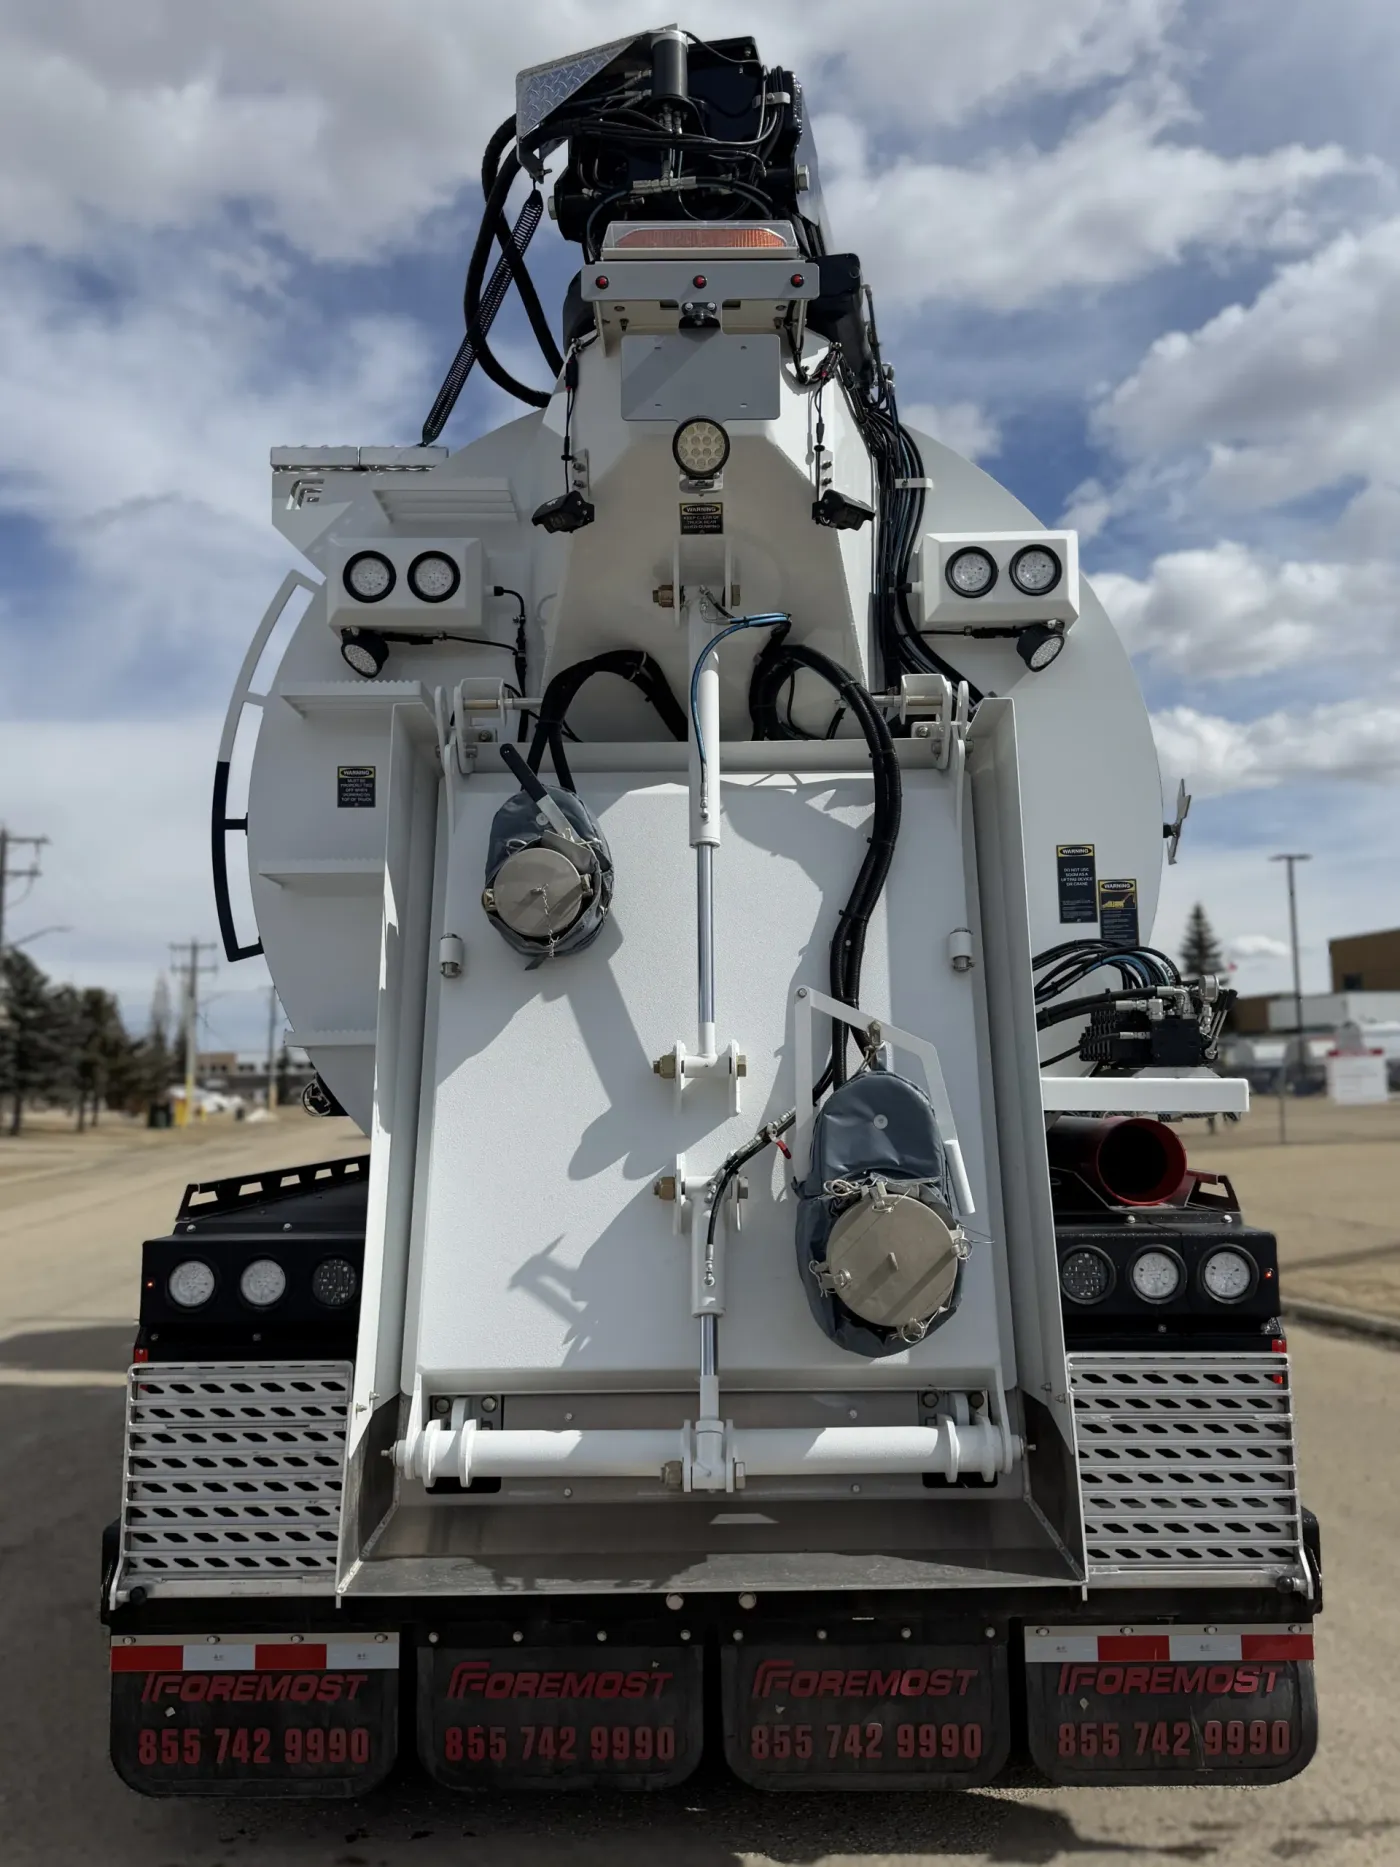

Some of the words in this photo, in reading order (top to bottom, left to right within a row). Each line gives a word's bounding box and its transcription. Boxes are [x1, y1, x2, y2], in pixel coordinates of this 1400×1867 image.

[141, 1671, 368, 1703] FOREMOST
[446, 1661, 674, 1699] FOREMOST
[751, 1659, 979, 1698] FOREMOST
[1057, 1662, 1284, 1696] FOREMOST
[138, 1728, 200, 1765] 855
[214, 1727, 270, 1764] 742
[284, 1727, 369, 1763] 9990
[445, 1726, 507, 1761] 855
[520, 1726, 577, 1760] 742
[590, 1726, 675, 1760] 9990
[751, 1724, 813, 1760] 855
[827, 1723, 883, 1759] 742
[896, 1723, 982, 1759] 9990
[1057, 1722, 1120, 1758] 855
[1134, 1721, 1191, 1757] 742
[1204, 1720, 1290, 1756] 9990
